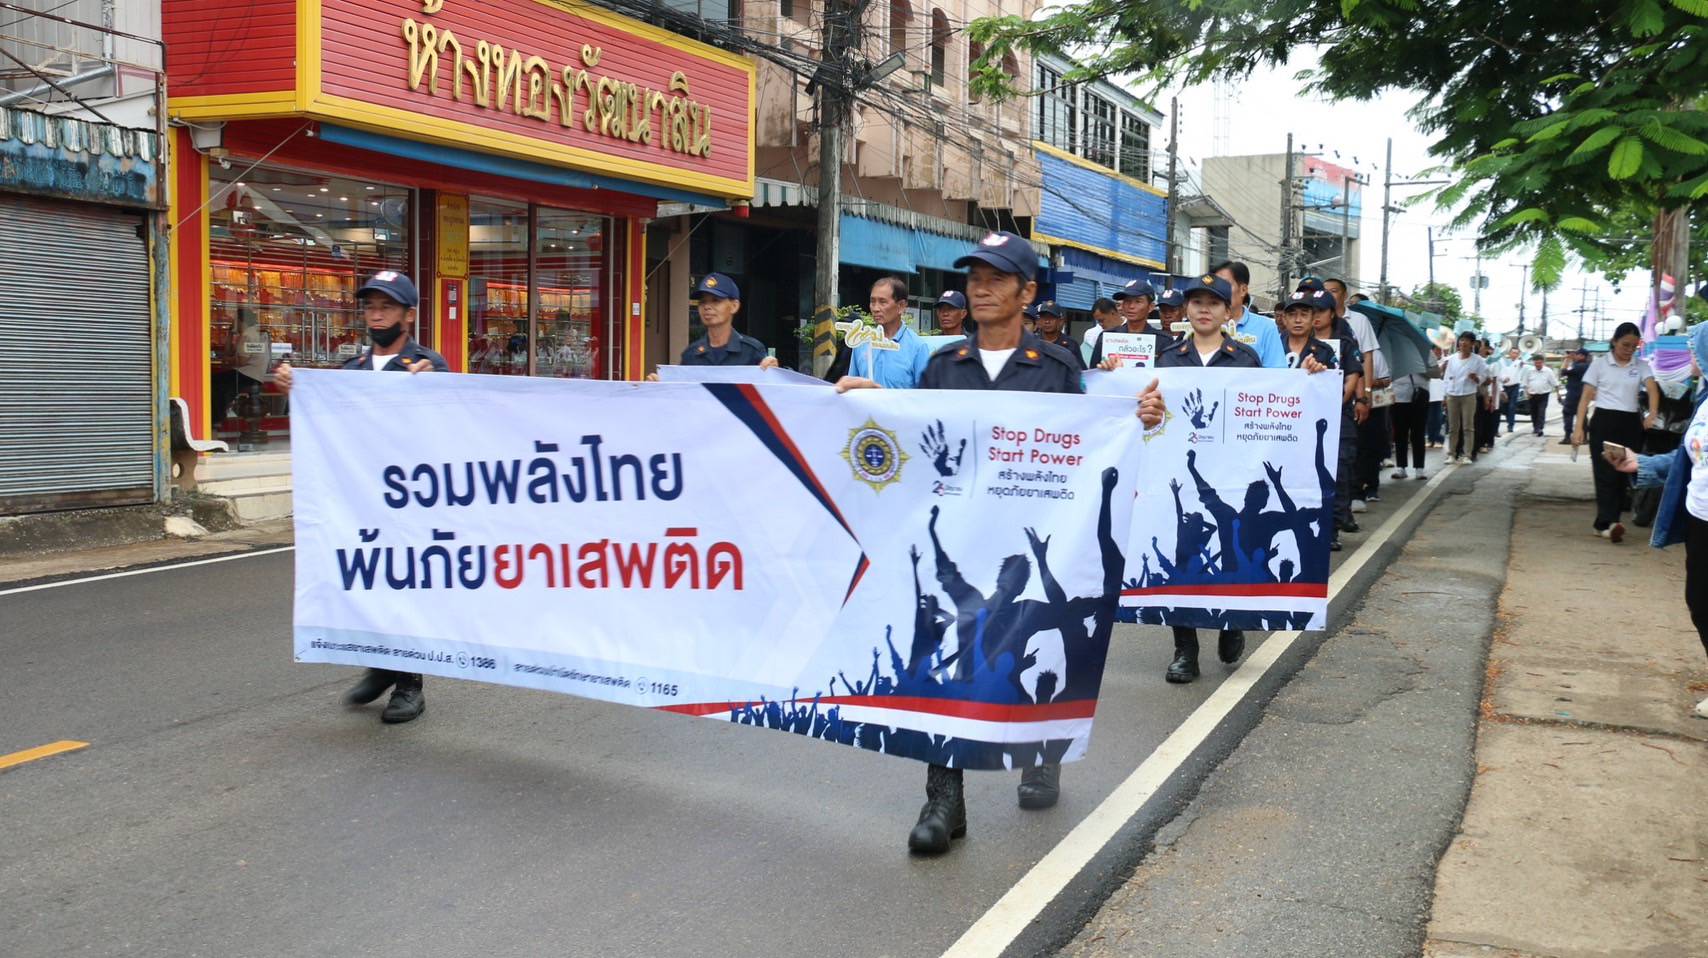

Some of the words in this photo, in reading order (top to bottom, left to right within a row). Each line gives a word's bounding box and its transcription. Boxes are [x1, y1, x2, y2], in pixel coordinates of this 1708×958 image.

[1237, 392, 1264, 407] Stop
[1268, 393, 1301, 407] Drugs
[1234, 407, 1262, 418] Start
[1266, 408, 1303, 419] Power
[1244, 420, 1292, 431] สร้างพลังไทย
[992, 426, 1027, 446] Stop
[1034, 428, 1081, 449] Drugs
[1236, 431, 1298, 443] หยุดภัยยาเสพติด
[988, 447, 1024, 463] Start
[1030, 449, 1083, 466] Power
[382, 434, 684, 510] รวมพลังไทย
[998, 468, 1068, 484] สร้างพลังไทย
[987, 484, 1075, 501] หยุดภัยยาเสพติด
[336, 527, 744, 591] พ้นภัยยาเสพติด
[427, 650, 454, 664] ป.ป.ส.
[470, 656, 496, 670] 1386
[651, 682, 678, 697] 1165
